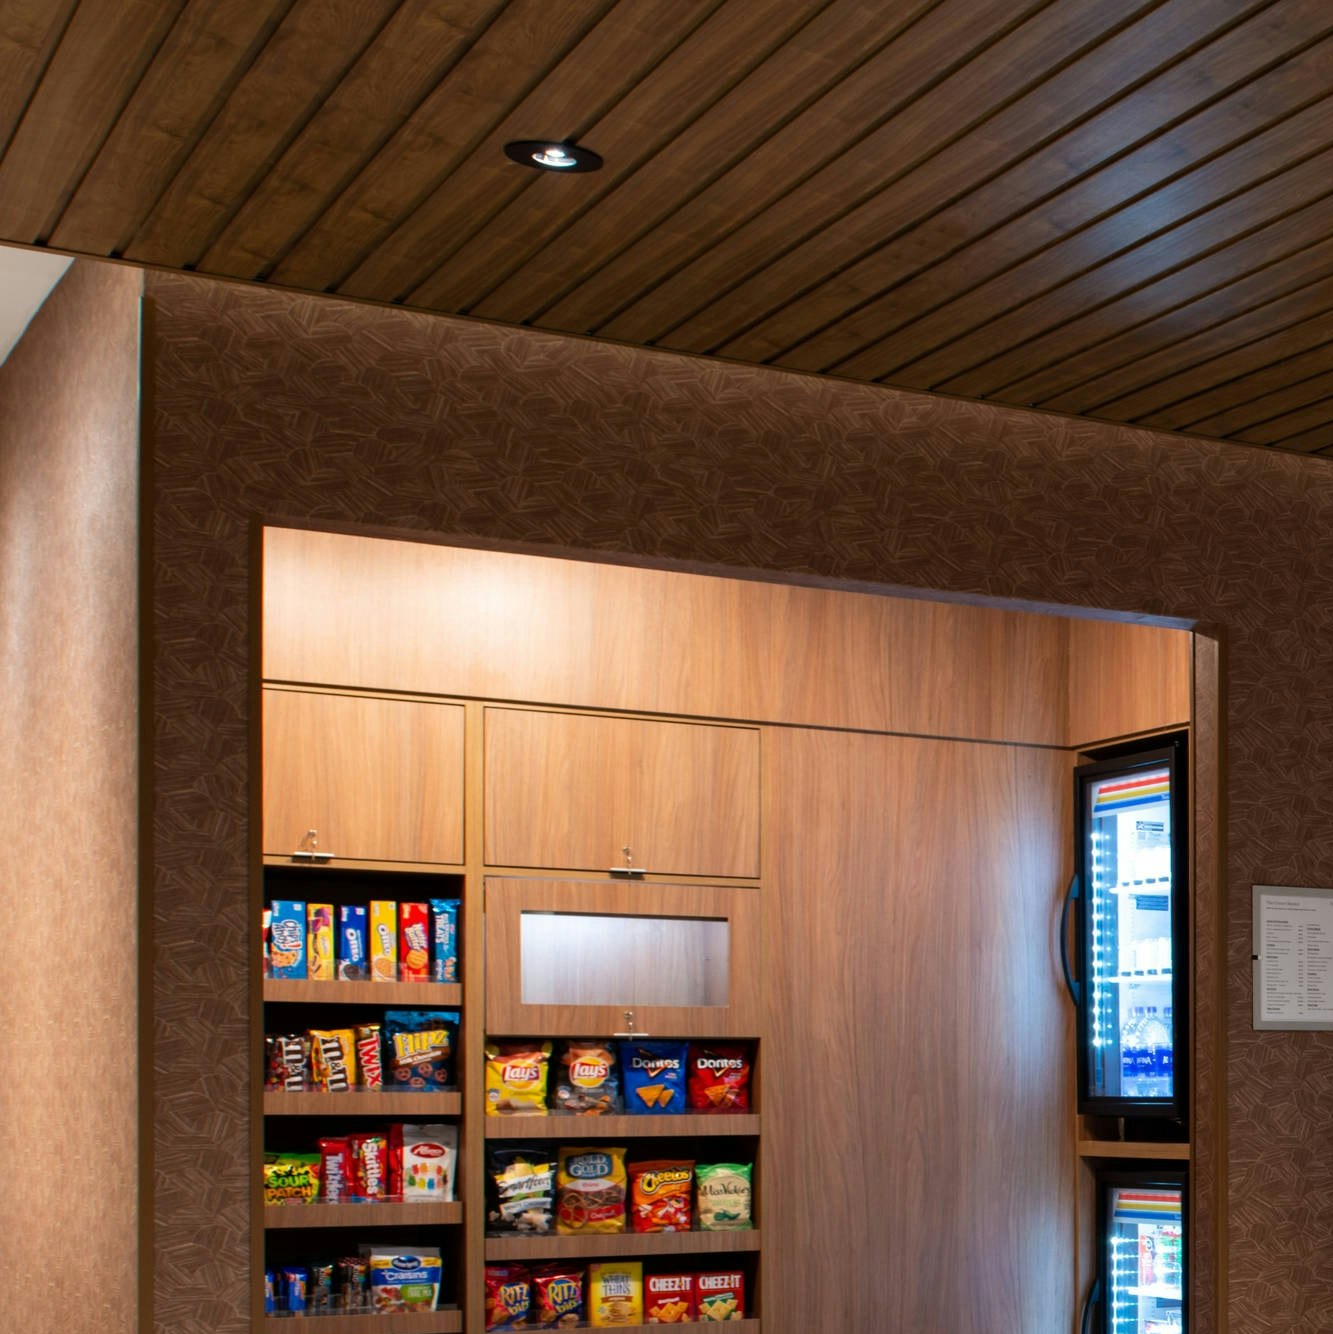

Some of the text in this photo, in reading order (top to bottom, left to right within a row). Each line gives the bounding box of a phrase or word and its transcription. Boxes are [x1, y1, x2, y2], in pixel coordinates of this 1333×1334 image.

[358, 1031, 383, 1088] TWIX
[632, 1057, 680, 1069] Doritos
[697, 1058, 743, 1069] Doritos
[361, 1142, 381, 1194] Skittles
[569, 1164, 609, 1176] GOLD
[267, 1174, 309, 1188] SOUR
[266, 1186, 312, 1199] PATCH
[500, 1283, 529, 1305] RITZ
[547, 1282, 578, 1305] RITZ
